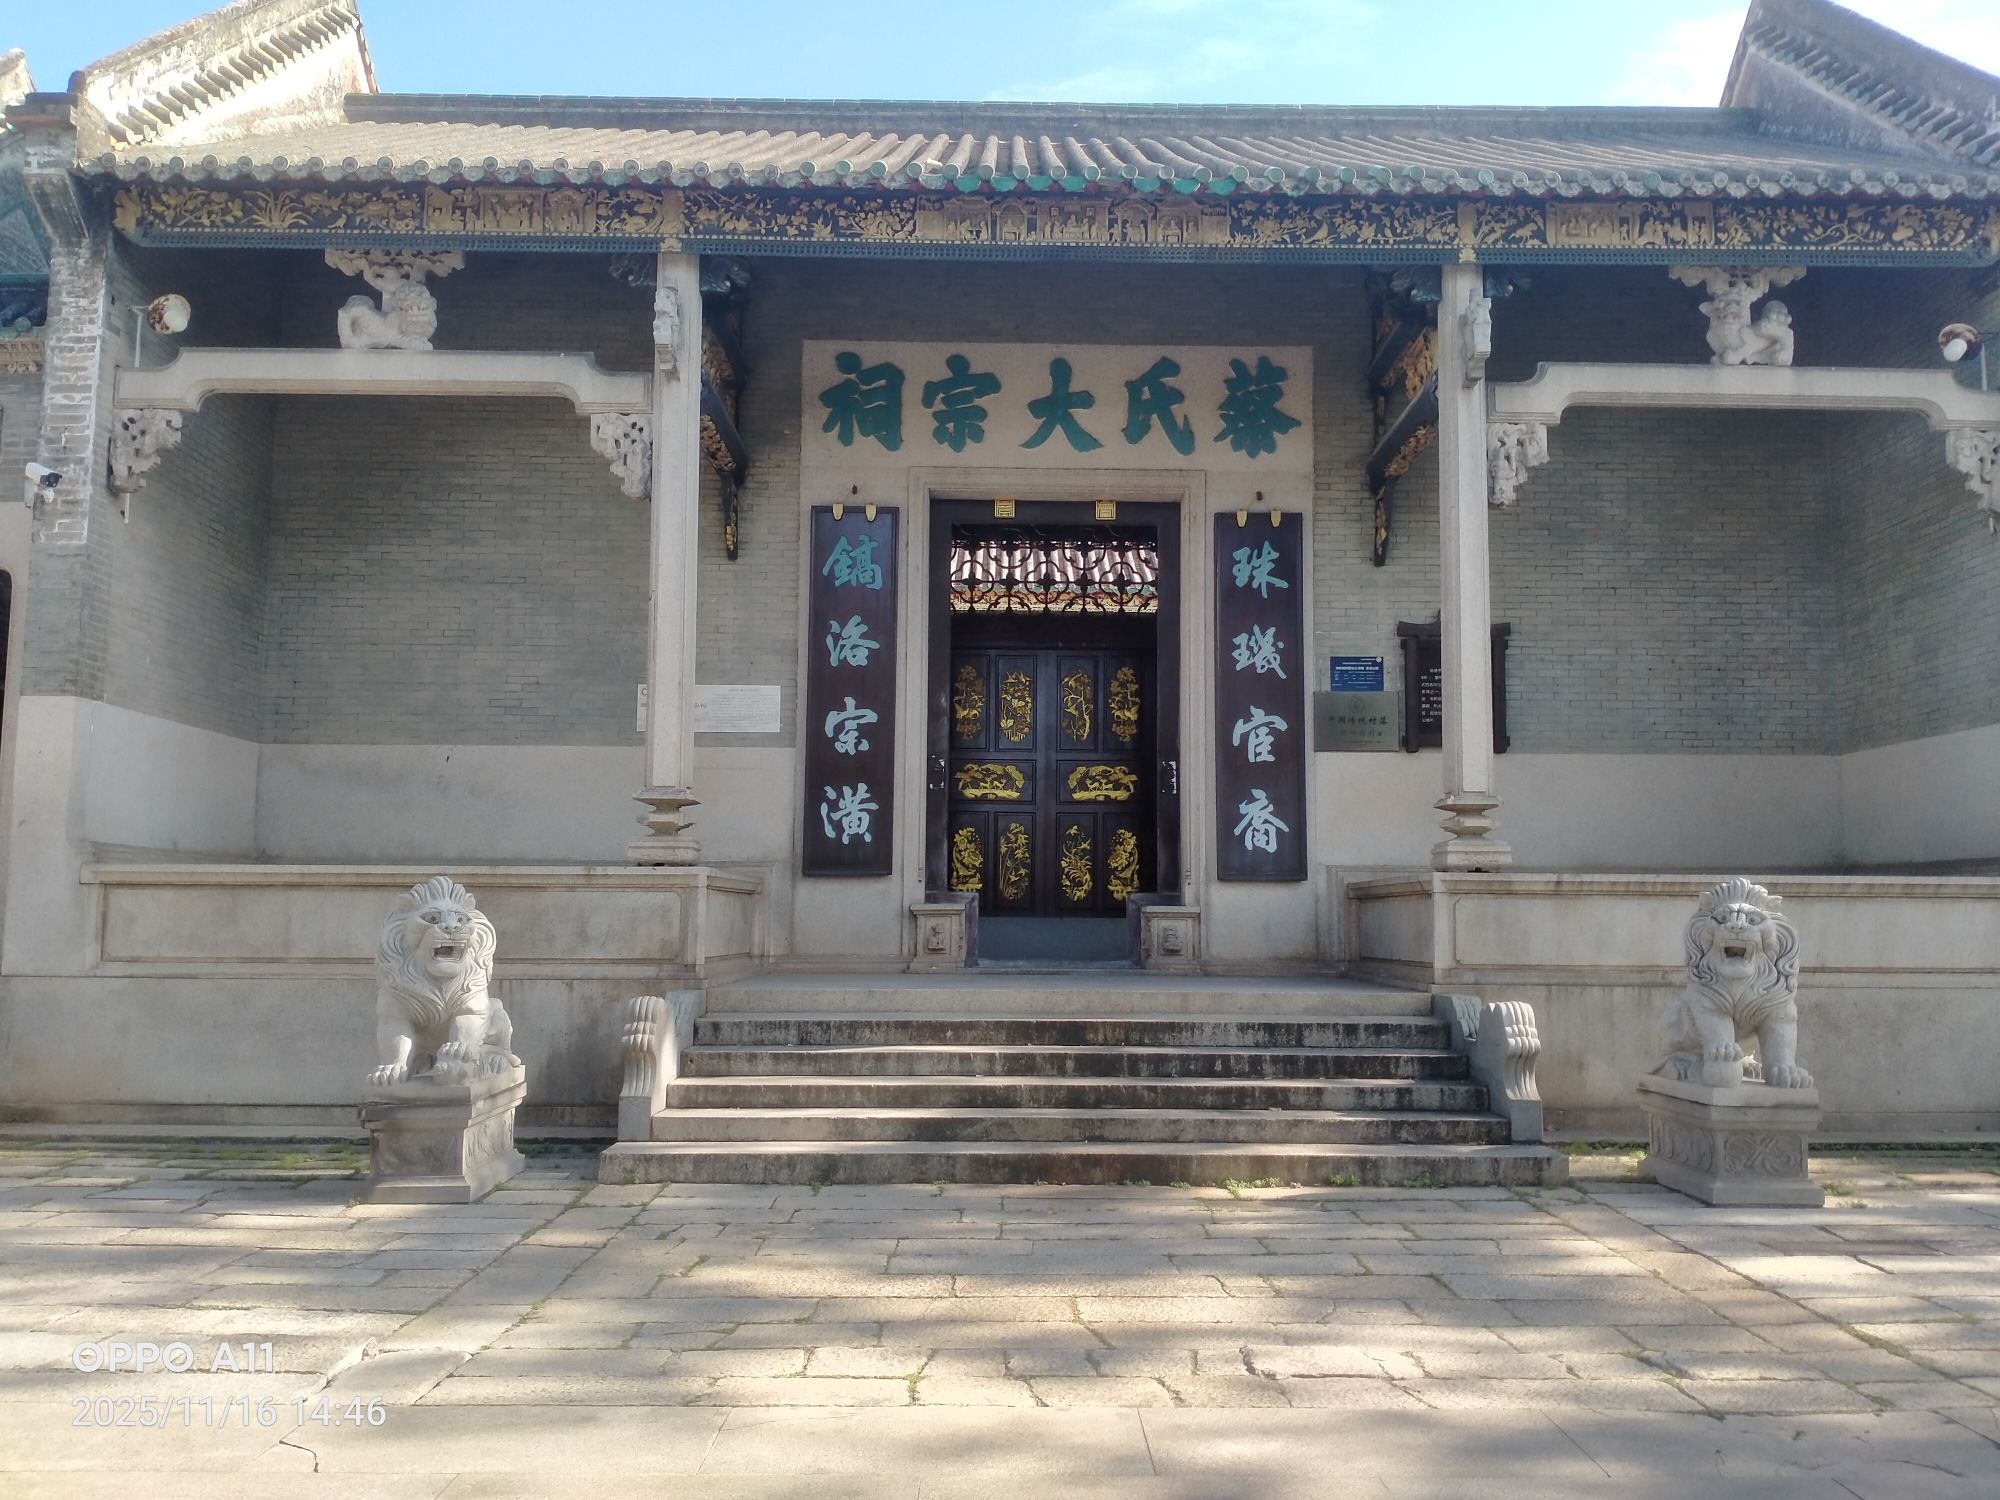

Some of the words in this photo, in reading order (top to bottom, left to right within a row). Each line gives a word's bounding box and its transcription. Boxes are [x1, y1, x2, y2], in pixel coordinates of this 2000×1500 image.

[818, 351, 1302, 459] 蔡氏大宗祠
